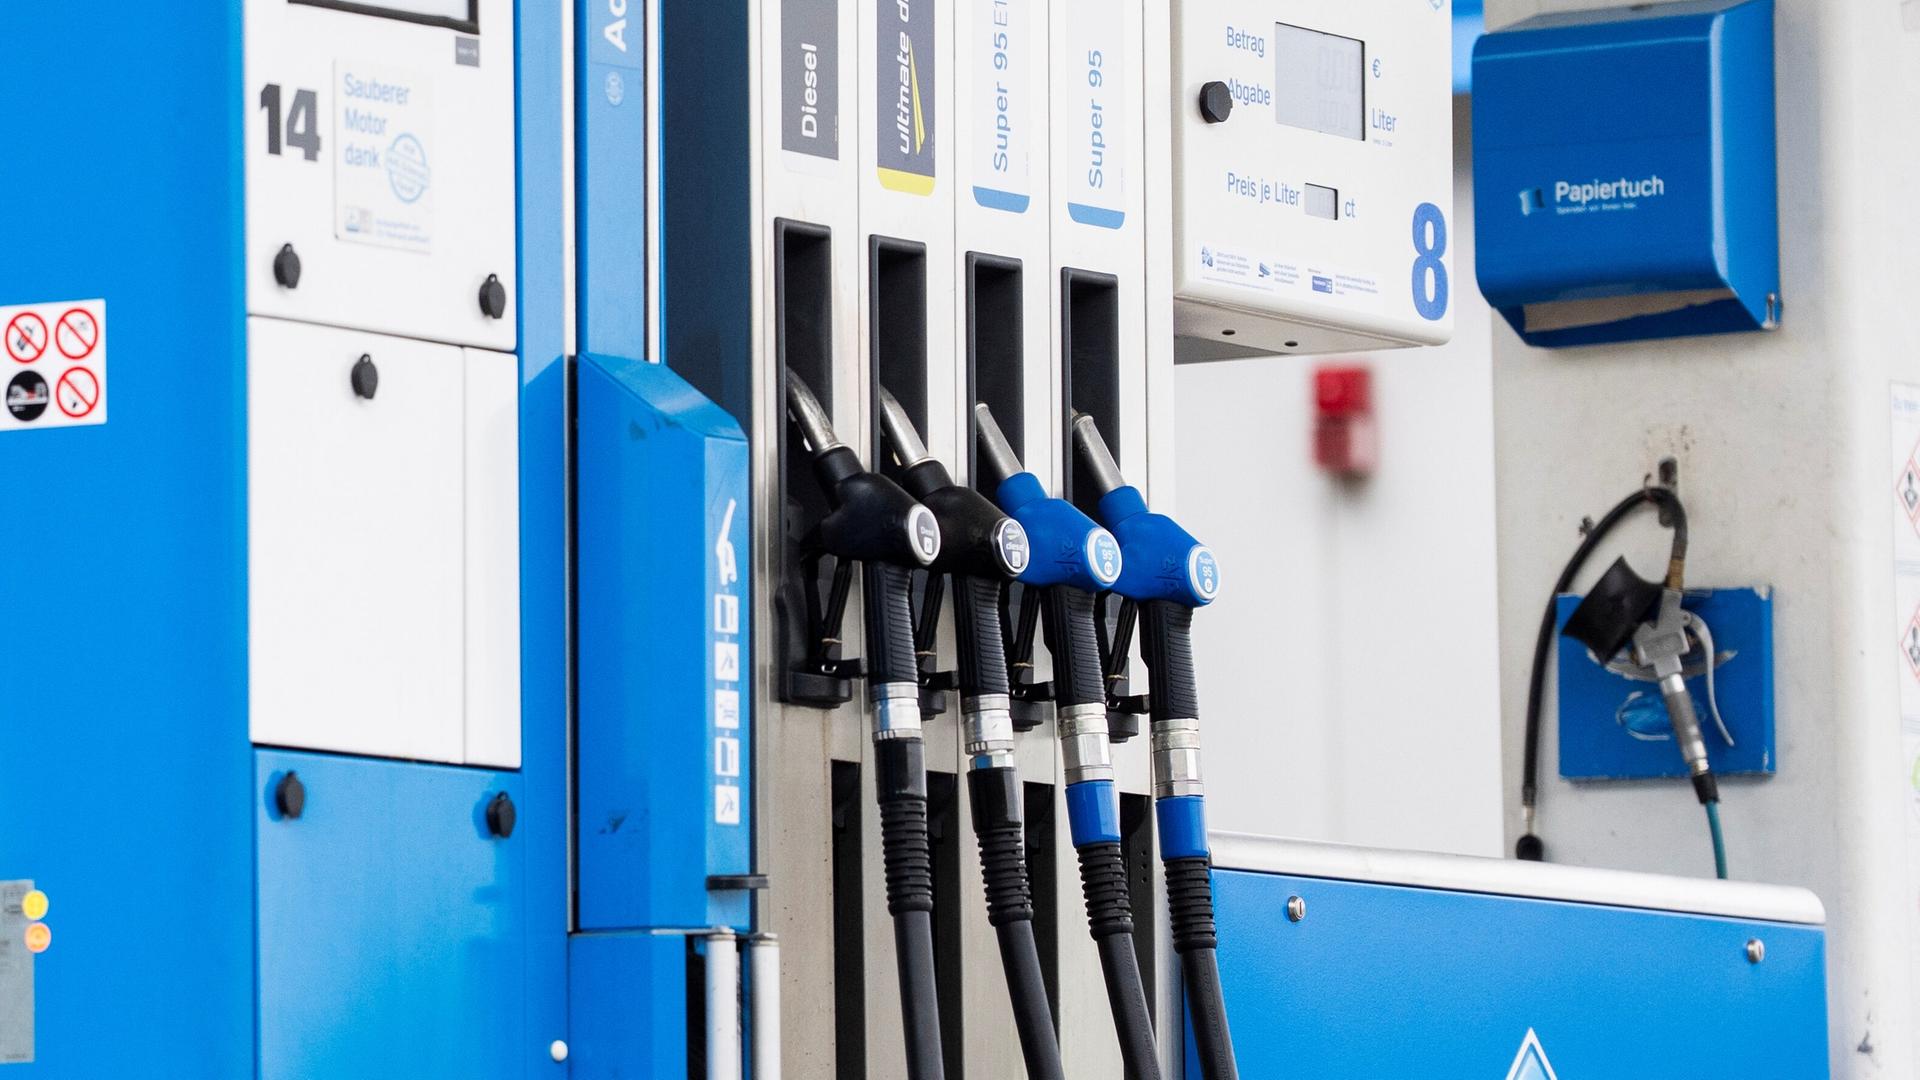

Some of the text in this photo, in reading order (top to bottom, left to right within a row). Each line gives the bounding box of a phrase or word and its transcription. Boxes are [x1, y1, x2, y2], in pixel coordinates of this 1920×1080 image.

[993, 32, 1008, 71] 95
[1226, 26, 1265, 58] Betrag
[344, 73, 410, 105] Sauberer
[801, 43, 818, 138] Diesel
[896, 0, 911, 155] ultimate d
[1227, 77, 1271, 106] Abgabe
[260, 83, 321, 162] 14
[344, 108, 388, 135] Motor
[993, 81, 1011, 173] Super
[1088, 50, 1106, 189] Super 95
[1372, 107, 1397, 133] Liter
[344, 144, 382, 168] dank
[1227, 172, 1300, 207] Preis je Liter
[1555, 175, 1665, 204] Papiertuch
[1344, 198, 1356, 218] ct
[1412, 202, 1448, 321] 8
